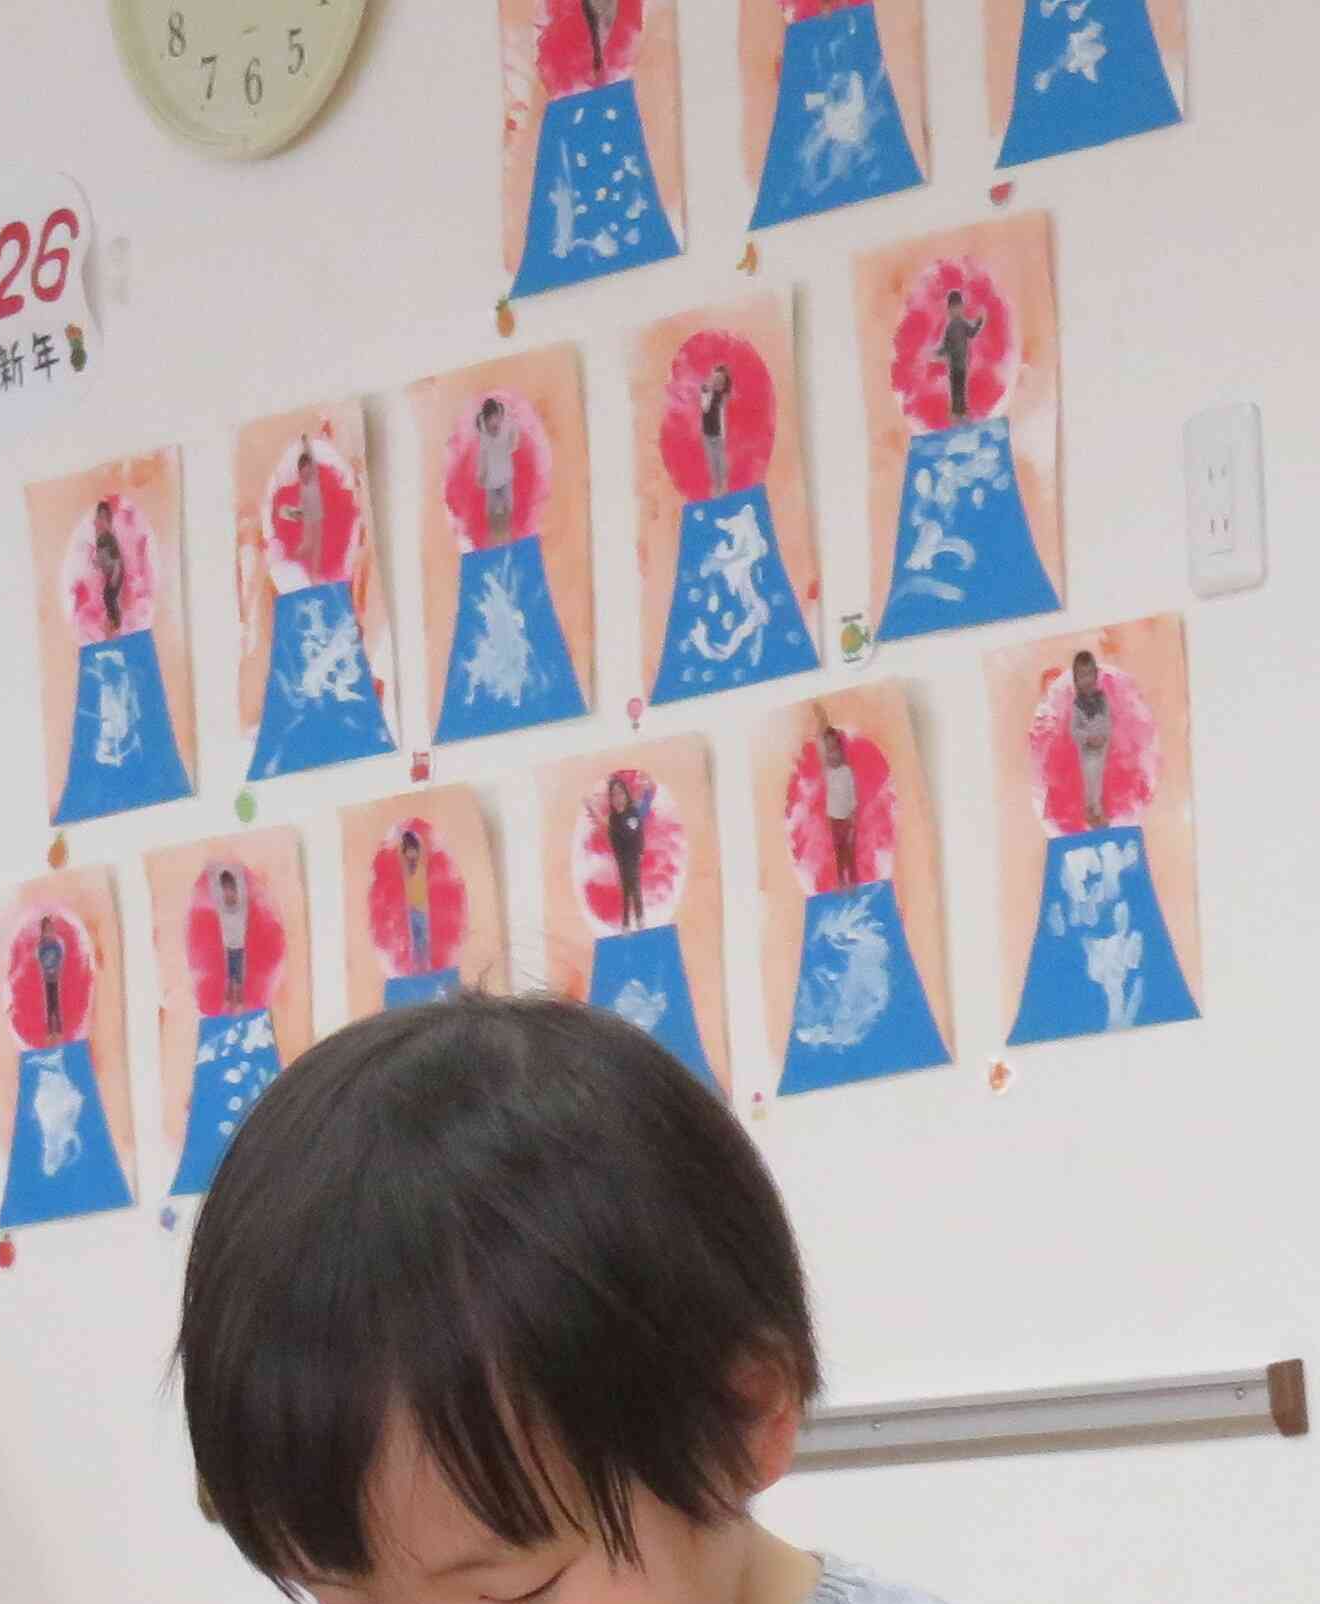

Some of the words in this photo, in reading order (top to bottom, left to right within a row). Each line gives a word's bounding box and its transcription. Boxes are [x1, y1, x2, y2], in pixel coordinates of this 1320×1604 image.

[168, 11, 186, 57] 8
[288, 27, 304, 74] 5
[201, 55, 216, 99] 7
[245, 57, 262, 105] 6
